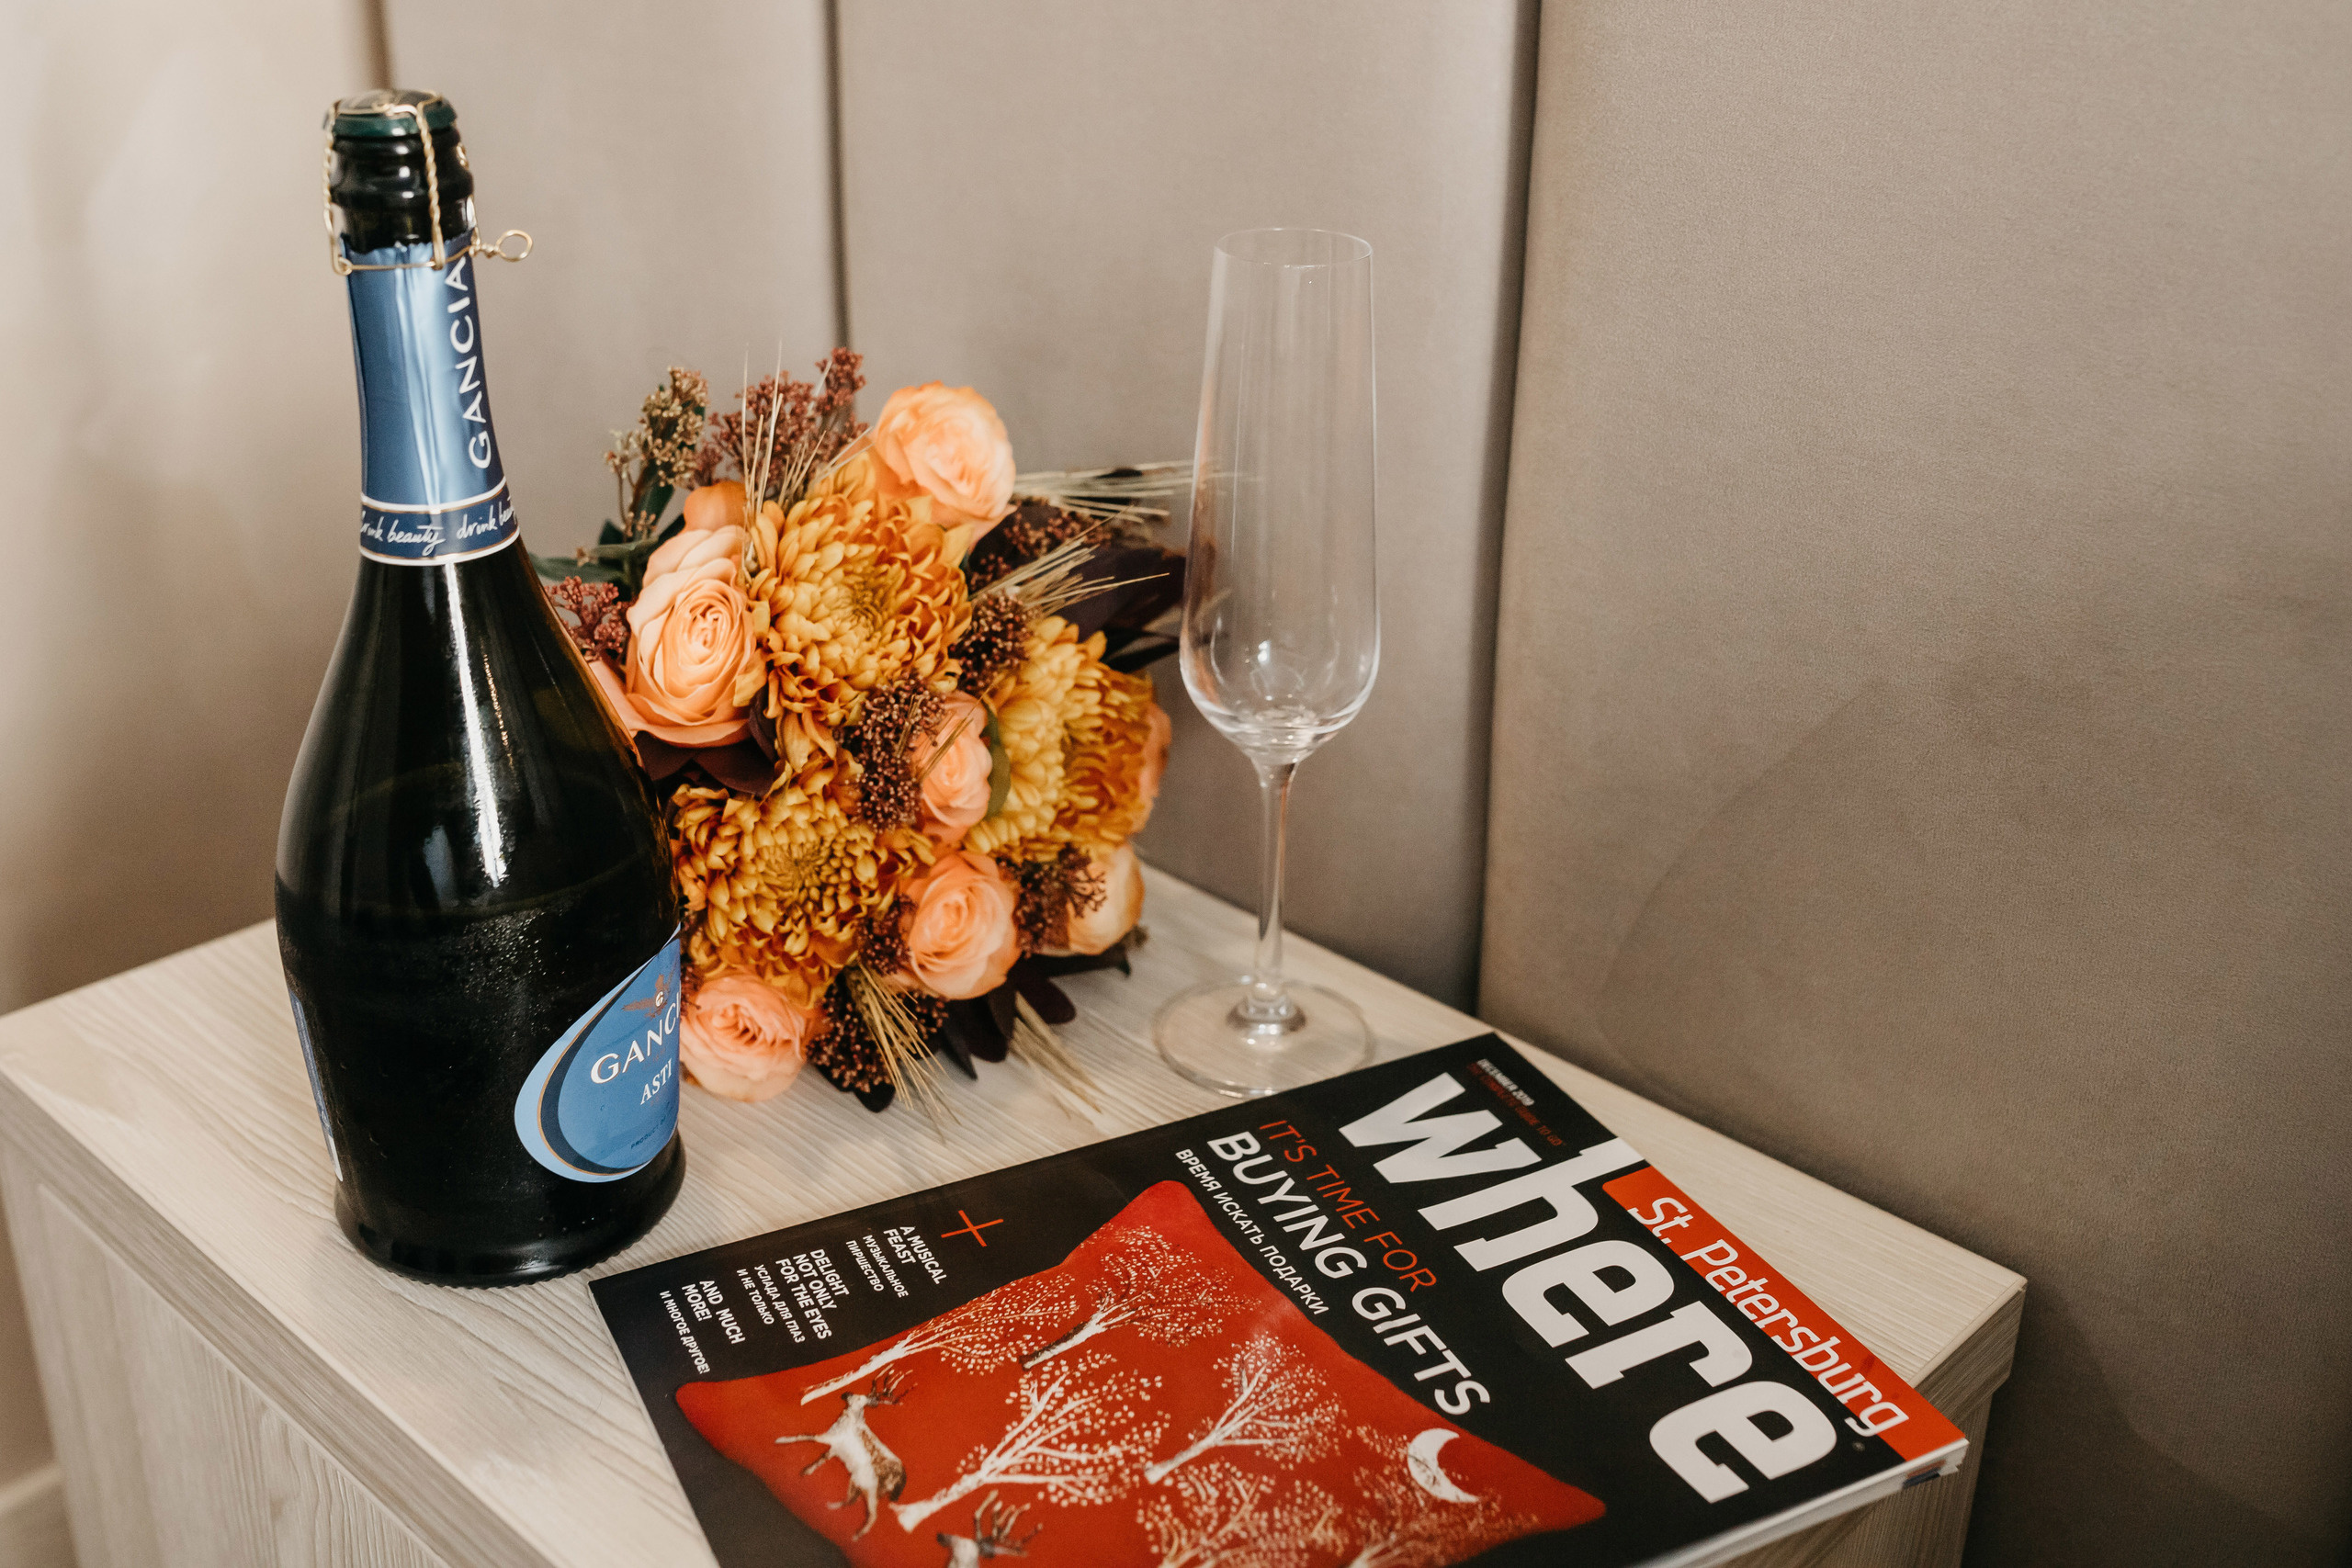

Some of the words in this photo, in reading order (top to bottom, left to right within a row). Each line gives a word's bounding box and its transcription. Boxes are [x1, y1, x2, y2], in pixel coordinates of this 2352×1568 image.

[445, 256, 492, 468] GANCIA
[387, 519, 446, 557] beauty
[457, 504, 498, 540] drink
[590, 987, 682, 1084] GANCI
[640, 1059, 673, 1105] ASTI
[899, 1226, 916, 1235] A
[1175, 1148, 1222, 1191] ВРЕМЯ
[1213, 1191, 1263, 1245] ИСКАТЬ
[1260, 1245, 1329, 1314] ПОДАРКИ
[1259, 1120, 1317, 1162] IT'S
[1306, 1164, 1380, 1229] TIME
[1363, 1231, 1437, 1292] FOR
[845, 1240, 884, 1292] ПИРШЕСТВО
[863, 1235, 909, 1298] МУЗЫКАЛЬНОЕ
[883, 1228, 917, 1264] FEAST
[907, 1235, 947, 1284] MUSICAL
[660, 1291, 672, 1299] И
[736, 1269, 749, 1277] И
[741, 1277, 755, 1290] НЕ
[775, 1258, 799, 1284] FOR
[791, 1283, 815, 1308] THE
[804, 1308, 832, 1339] EYES
[793, 1253, 819, 1278] NOT
[808, 1280, 837, 1310] ONLY
[809, 1249, 850, 1296] DELIGHT
[1207, 1131, 1368, 1279] BUYING
[1351, 1287, 1490, 1416] GIFTS
[1339, 1071, 1838, 1505] where
[663, 1299, 691, 1336] МНОГОЕ
[682, 1283, 712, 1322] MORE!
[699, 1280, 724, 1304] AND
[716, 1308, 746, 1344] MUCH
[749, 1289, 775, 1325] ТОЛЬКО
[754, 1264, 781, 1300] УСЛАДА
[772, 1301, 793, 1320] ДЛЯ
[786, 1319, 806, 1343] ГЛАЗ
[1626, 1197, 1691, 1245] St.
[1679, 1238, 1909, 1438] Petersburg
[680, 1336, 710, 1374] ДРУГОЕ!
